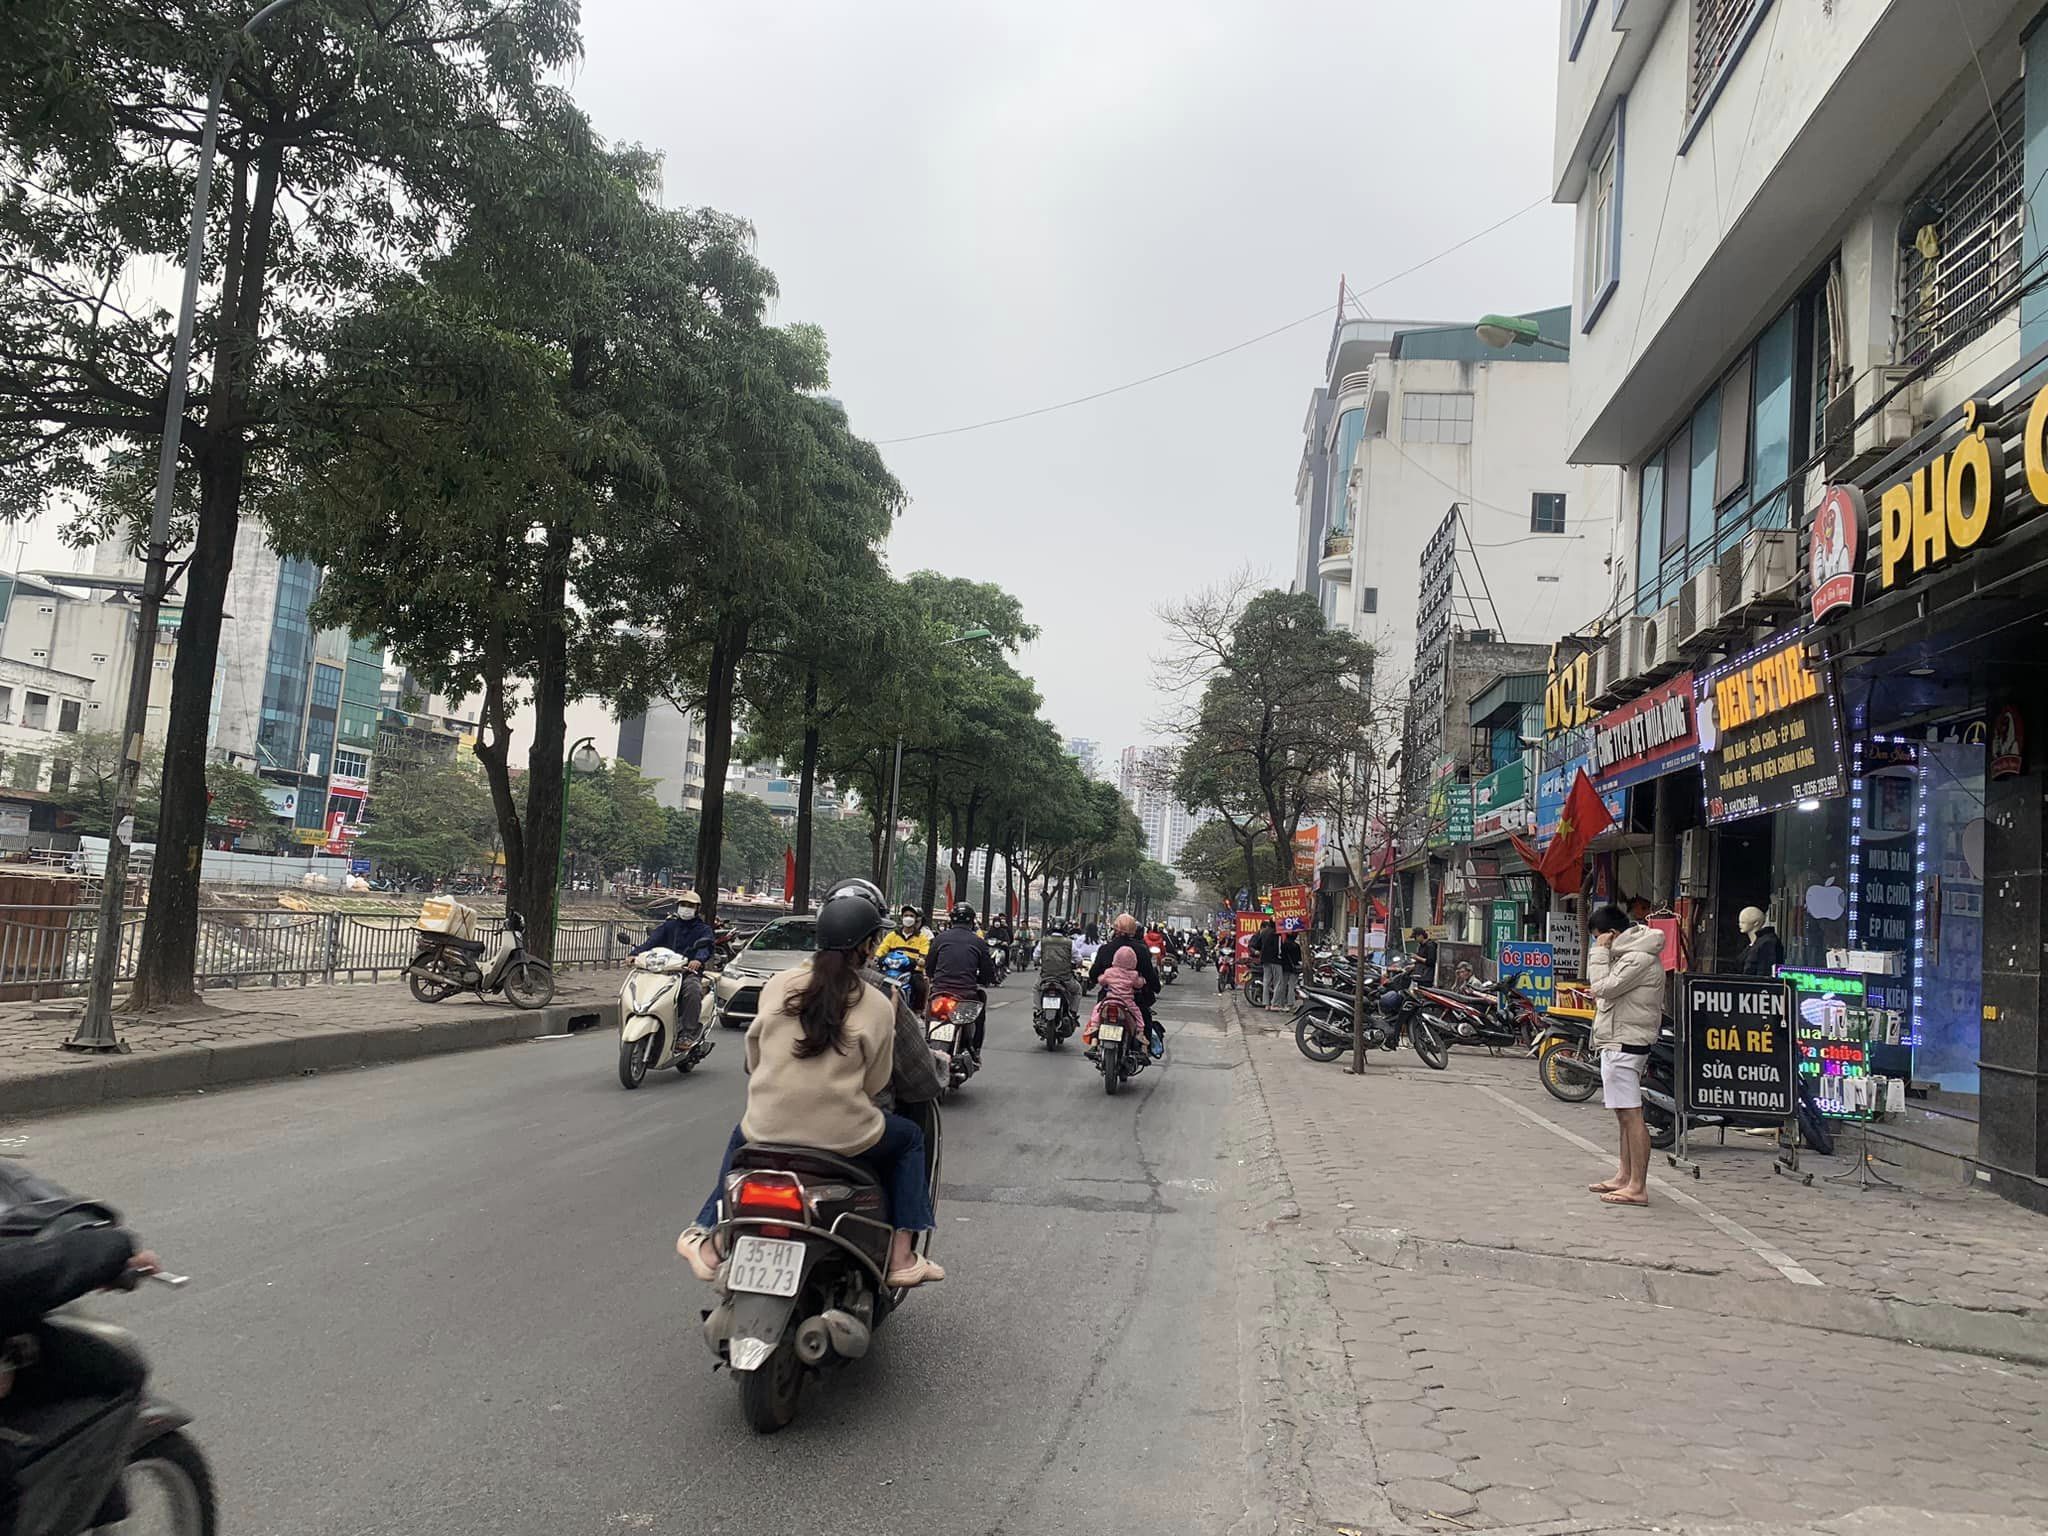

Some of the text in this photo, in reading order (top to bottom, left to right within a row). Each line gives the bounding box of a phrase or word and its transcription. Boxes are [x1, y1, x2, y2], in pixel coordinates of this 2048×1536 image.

[1881, 399, 1991, 589] PHỞ
[1693, 989, 1785, 1019] PHỤ KIỆN
[1706, 1023, 1774, 1053] GIÁ RẺ
[1702, 1059, 1780, 1082] SỬA CHỮA
[1697, 1086, 1785, 1111] ĐIỆN THOẠI
[734, 1264, 794, 1291] 012.73
